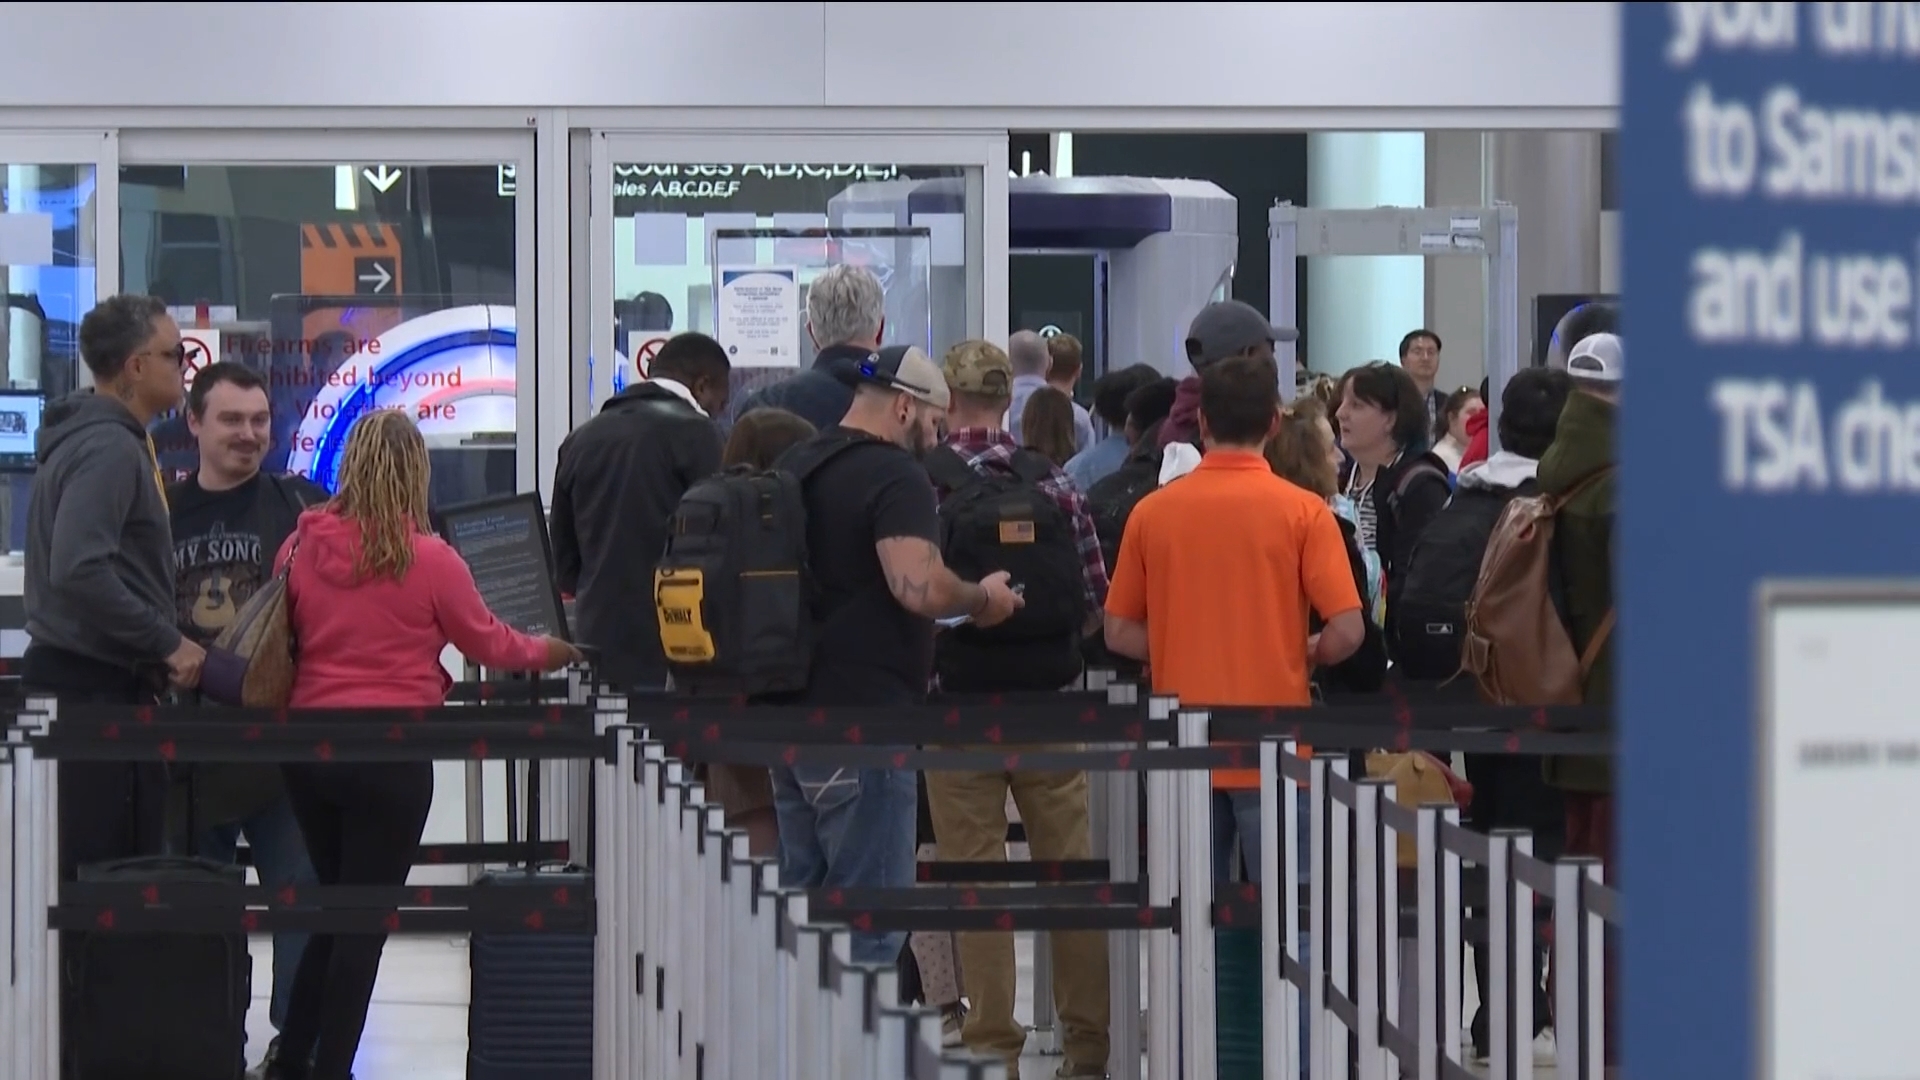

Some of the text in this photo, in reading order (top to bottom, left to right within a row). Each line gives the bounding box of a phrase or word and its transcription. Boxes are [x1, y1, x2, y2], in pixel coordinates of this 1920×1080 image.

[1687, 82, 1755, 192] to
[1689, 233, 1911, 344] and use
[226, 334, 382, 355] Firearms are
[367, 365, 462, 392] beyond
[417, 403, 457, 420] are
[1711, 379, 1828, 488] TSA
